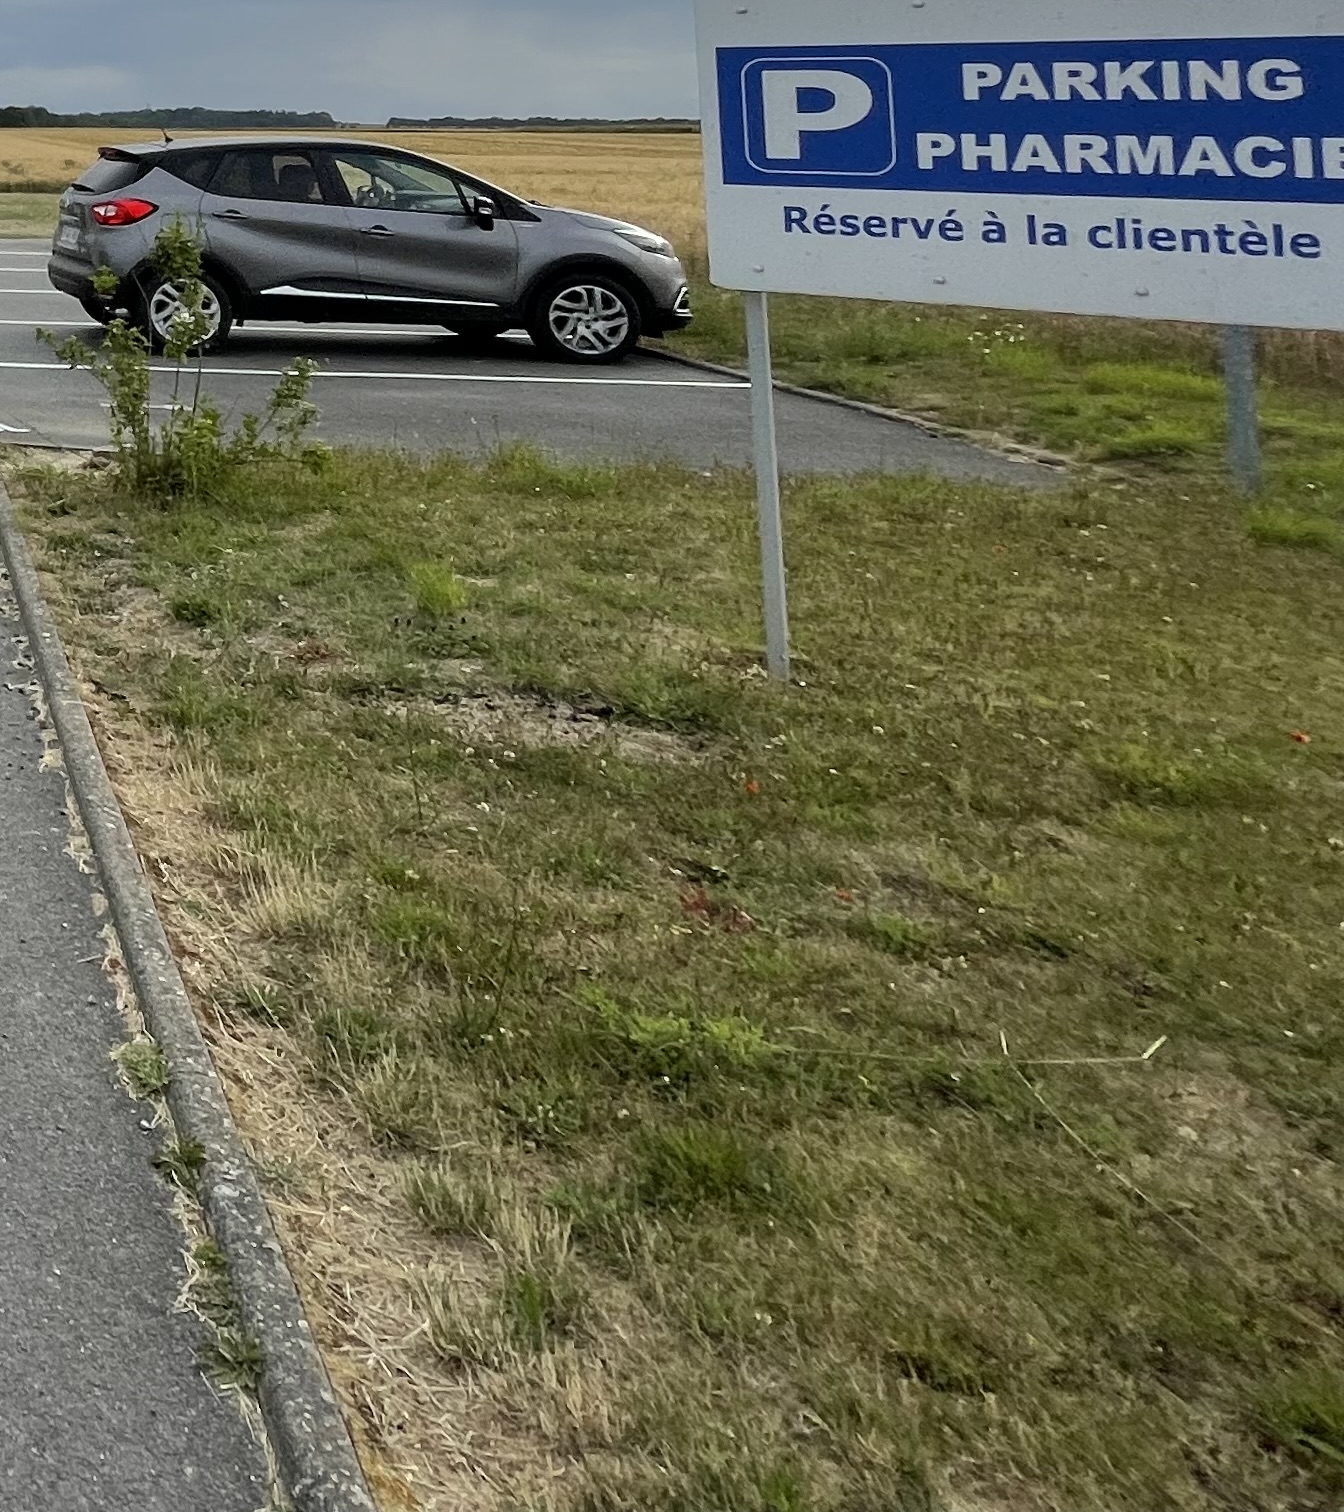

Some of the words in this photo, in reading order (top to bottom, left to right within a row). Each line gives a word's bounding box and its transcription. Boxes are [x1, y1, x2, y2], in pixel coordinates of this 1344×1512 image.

[961, 58, 1304, 101] PARKING
[760, 69, 874, 160] P
[783, 203, 964, 243] Réservé
[981, 210, 1007, 245] à
[1026, 214, 1067, 248] la
[1087, 217, 1322, 259] clientèle
